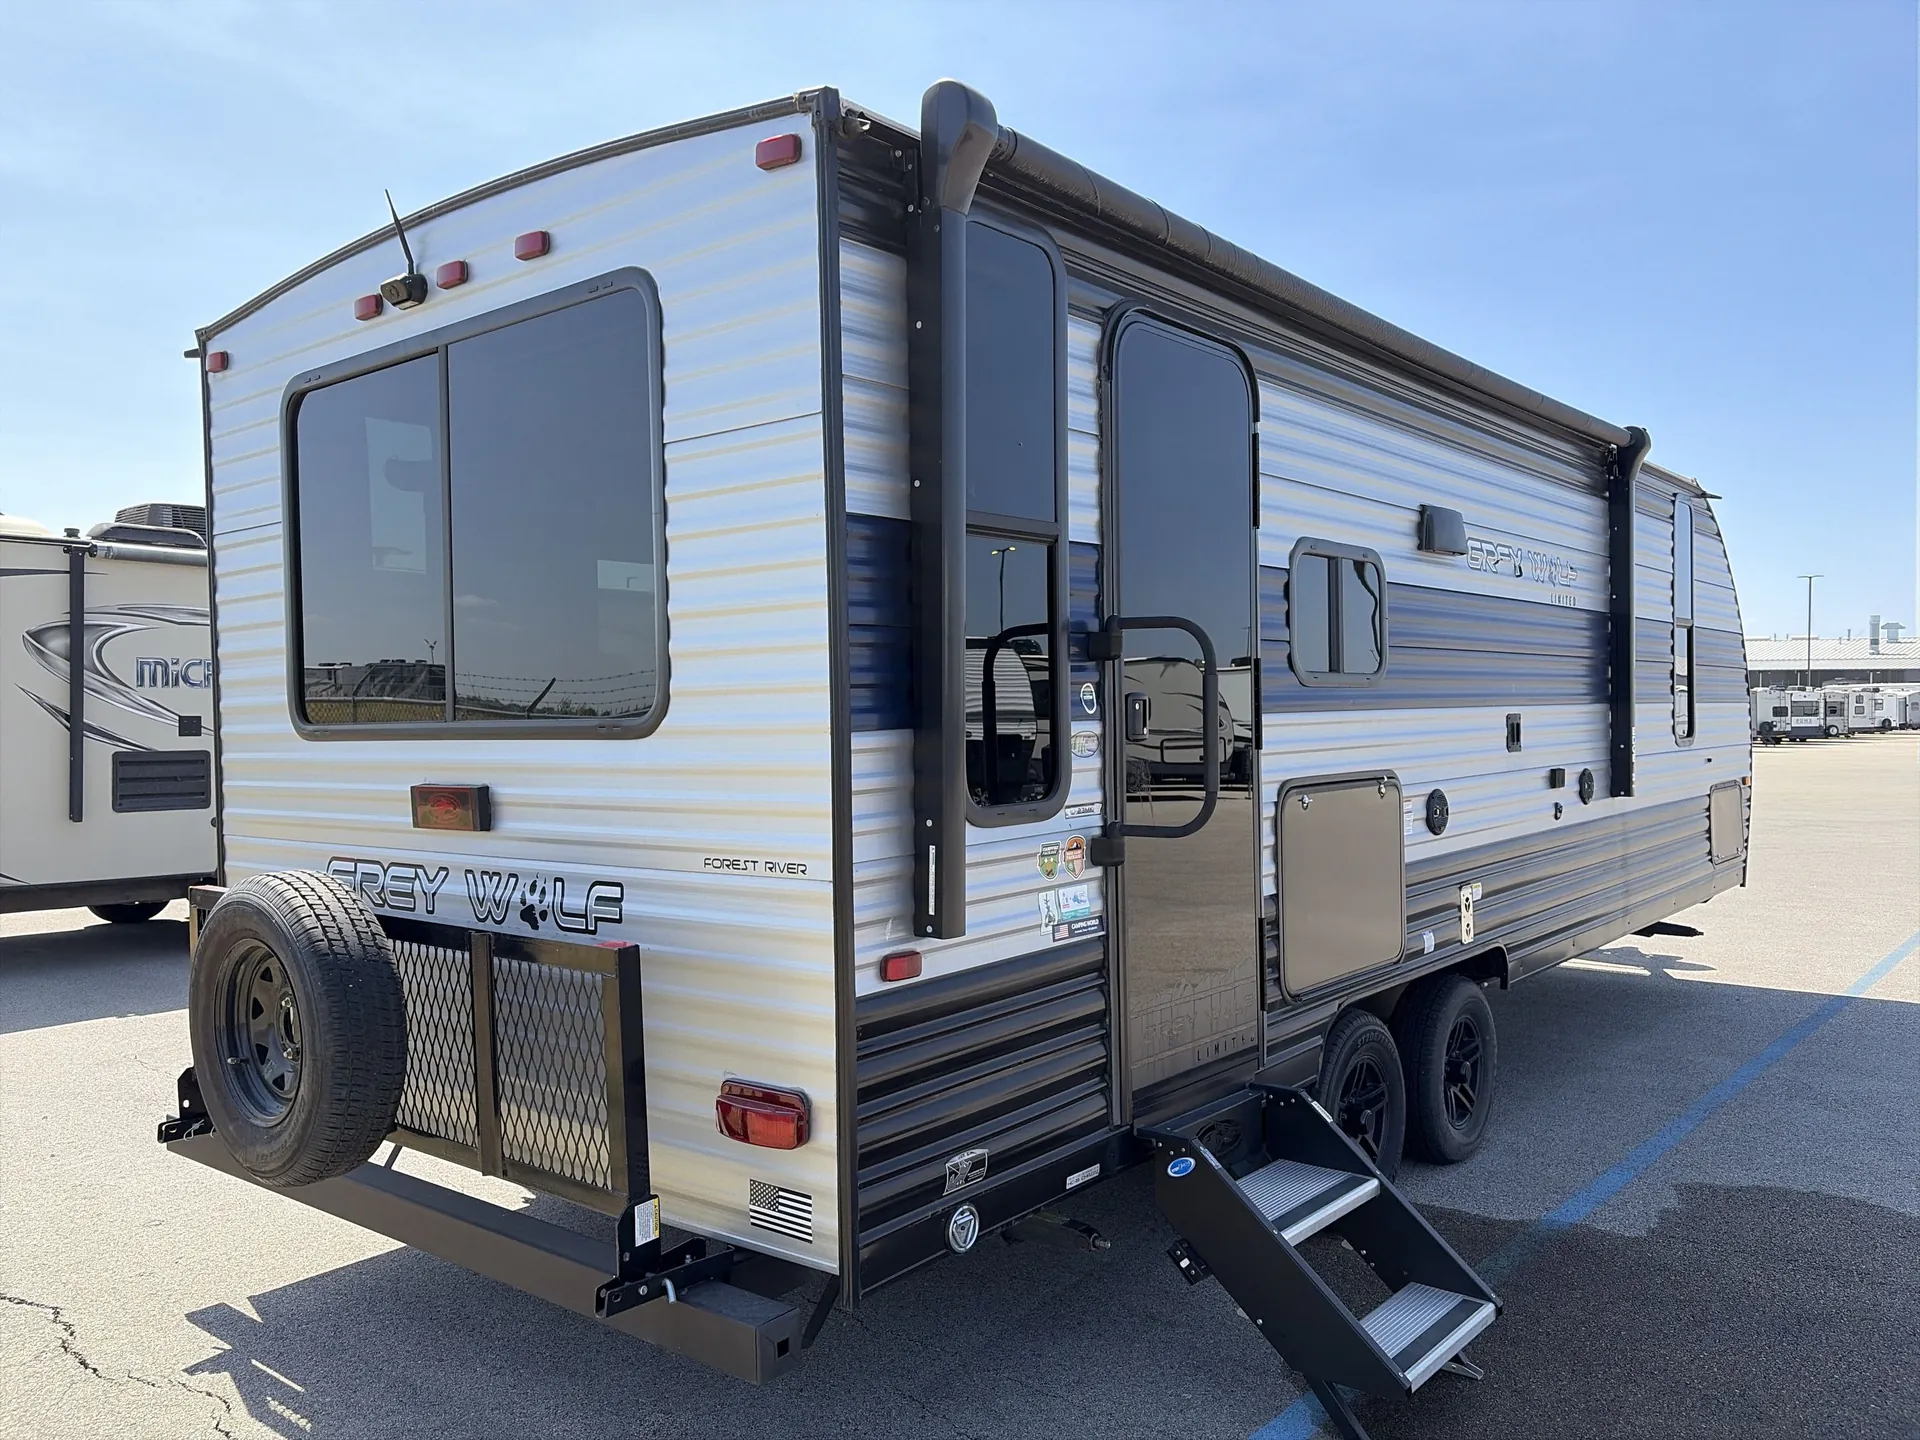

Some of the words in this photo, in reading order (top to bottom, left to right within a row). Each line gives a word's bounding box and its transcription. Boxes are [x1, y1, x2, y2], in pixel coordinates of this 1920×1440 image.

[1466, 537, 1523, 578] GREY
[1550, 592, 1577, 607] LIMITED
[703, 857, 758, 872] FOREST
[764, 860, 808, 876] RIVER
